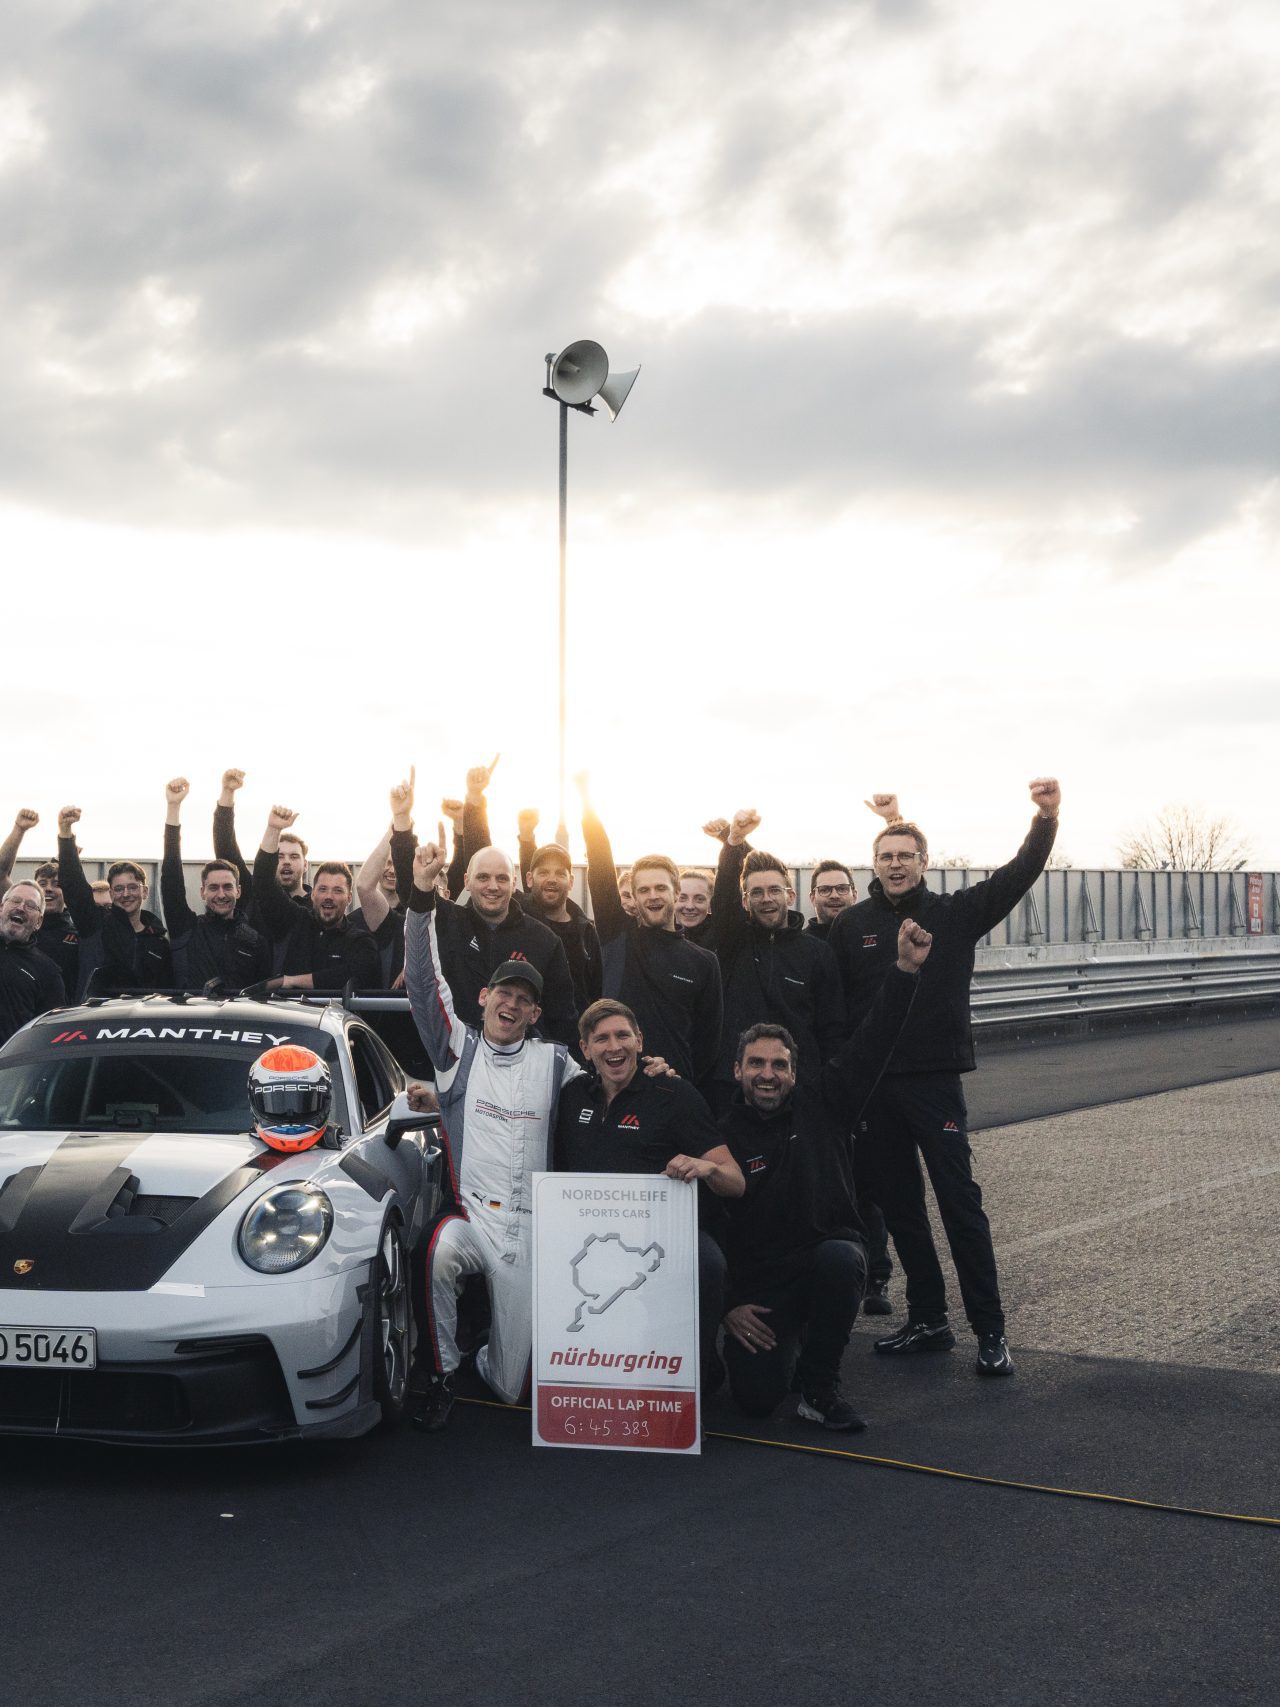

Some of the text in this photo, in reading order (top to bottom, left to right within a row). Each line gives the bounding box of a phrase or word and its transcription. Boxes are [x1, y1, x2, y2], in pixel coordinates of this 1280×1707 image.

[95, 1028, 291, 1046] MANTHEY
[254, 1084, 328, 1095] PORSCHE
[474, 1108, 508, 1123] MOTORSPORT
[476, 1099, 536, 1117] PORSCHE
[561, 1189, 668, 1202] NORDSCHLEIFE
[578, 1208, 651, 1219] SPORTS CARS
[15, 1333, 88, 1363] 5046
[549, 1347, 683, 1375] nürburgring
[551, 1396, 683, 1413] OFFICIAL LAP TIME
